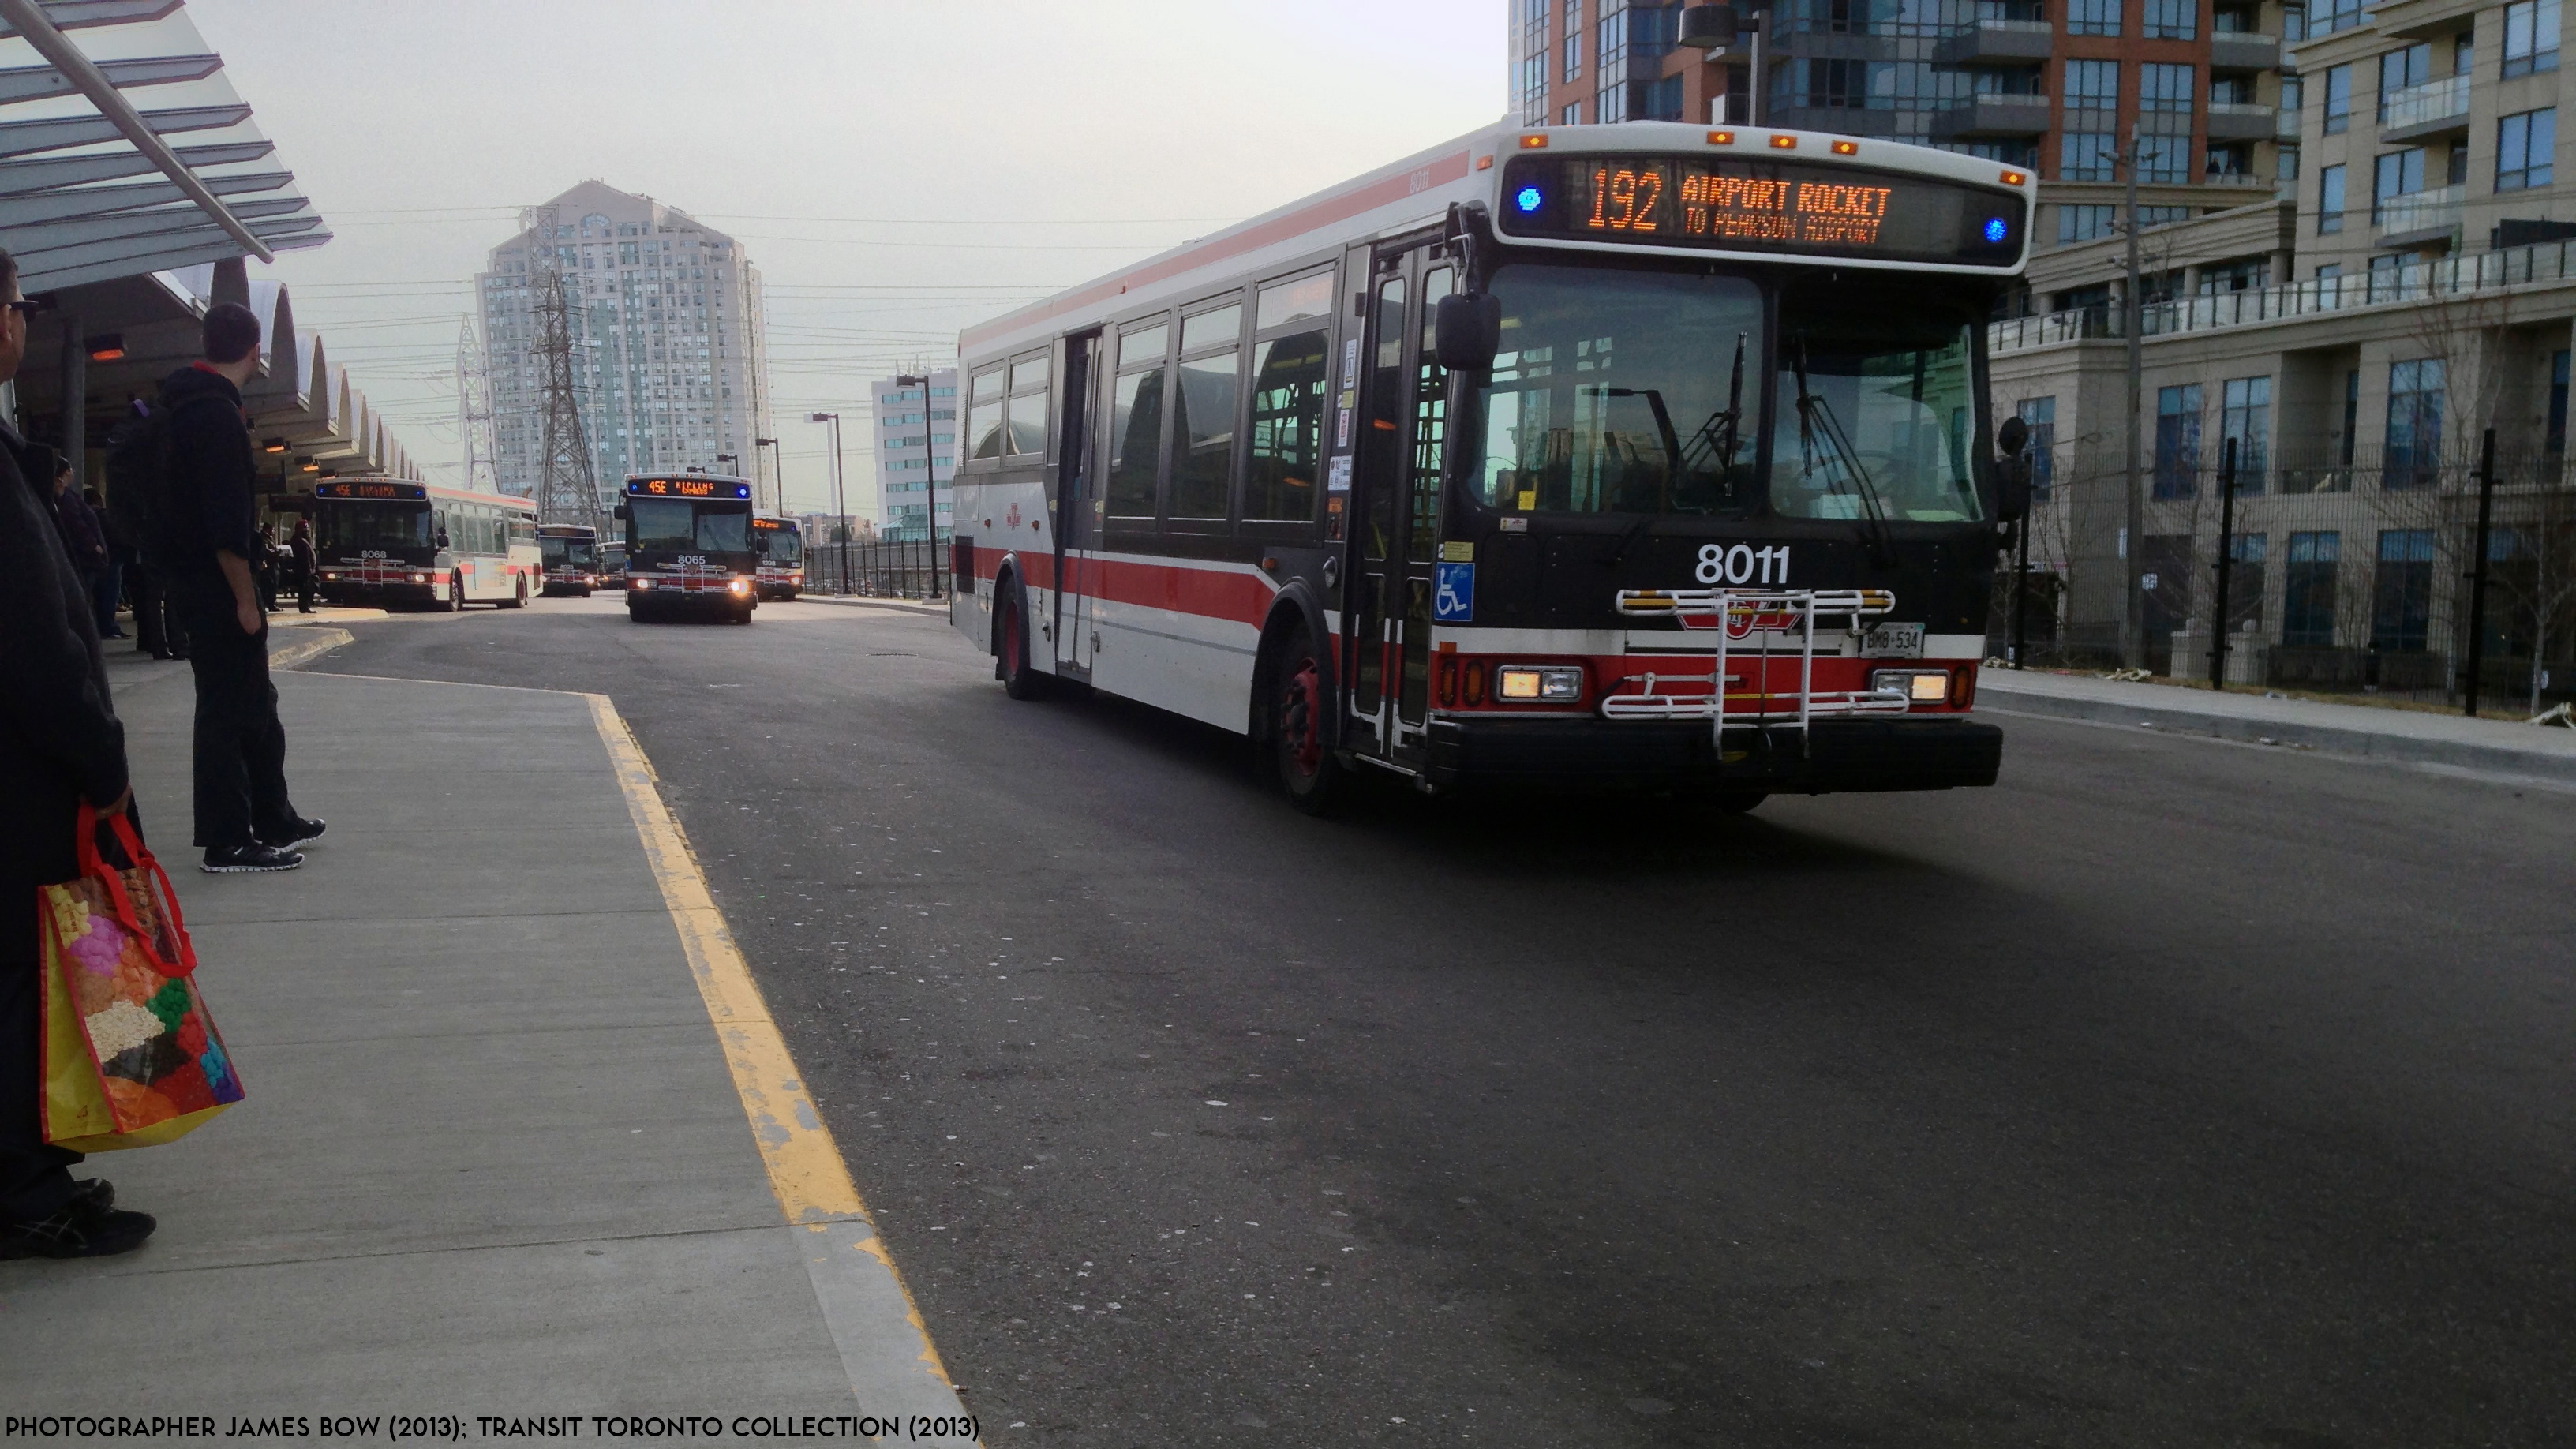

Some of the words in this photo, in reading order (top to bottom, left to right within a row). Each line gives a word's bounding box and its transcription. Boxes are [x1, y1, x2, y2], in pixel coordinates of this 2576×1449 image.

[1589, 168, 1661, 230] 192
[1681, 174, 1792, 209] AIRPORT
[1797, 182, 1892, 216] ROCKET
[1686, 208, 1707, 234] TO
[1803, 215, 1881, 244] AIRPORT
[648, 481, 667, 494] 45E
[361, 549, 388, 559] 8068
[677, 554, 706, 565] 8065
[1695, 543, 1790, 585] 8011
